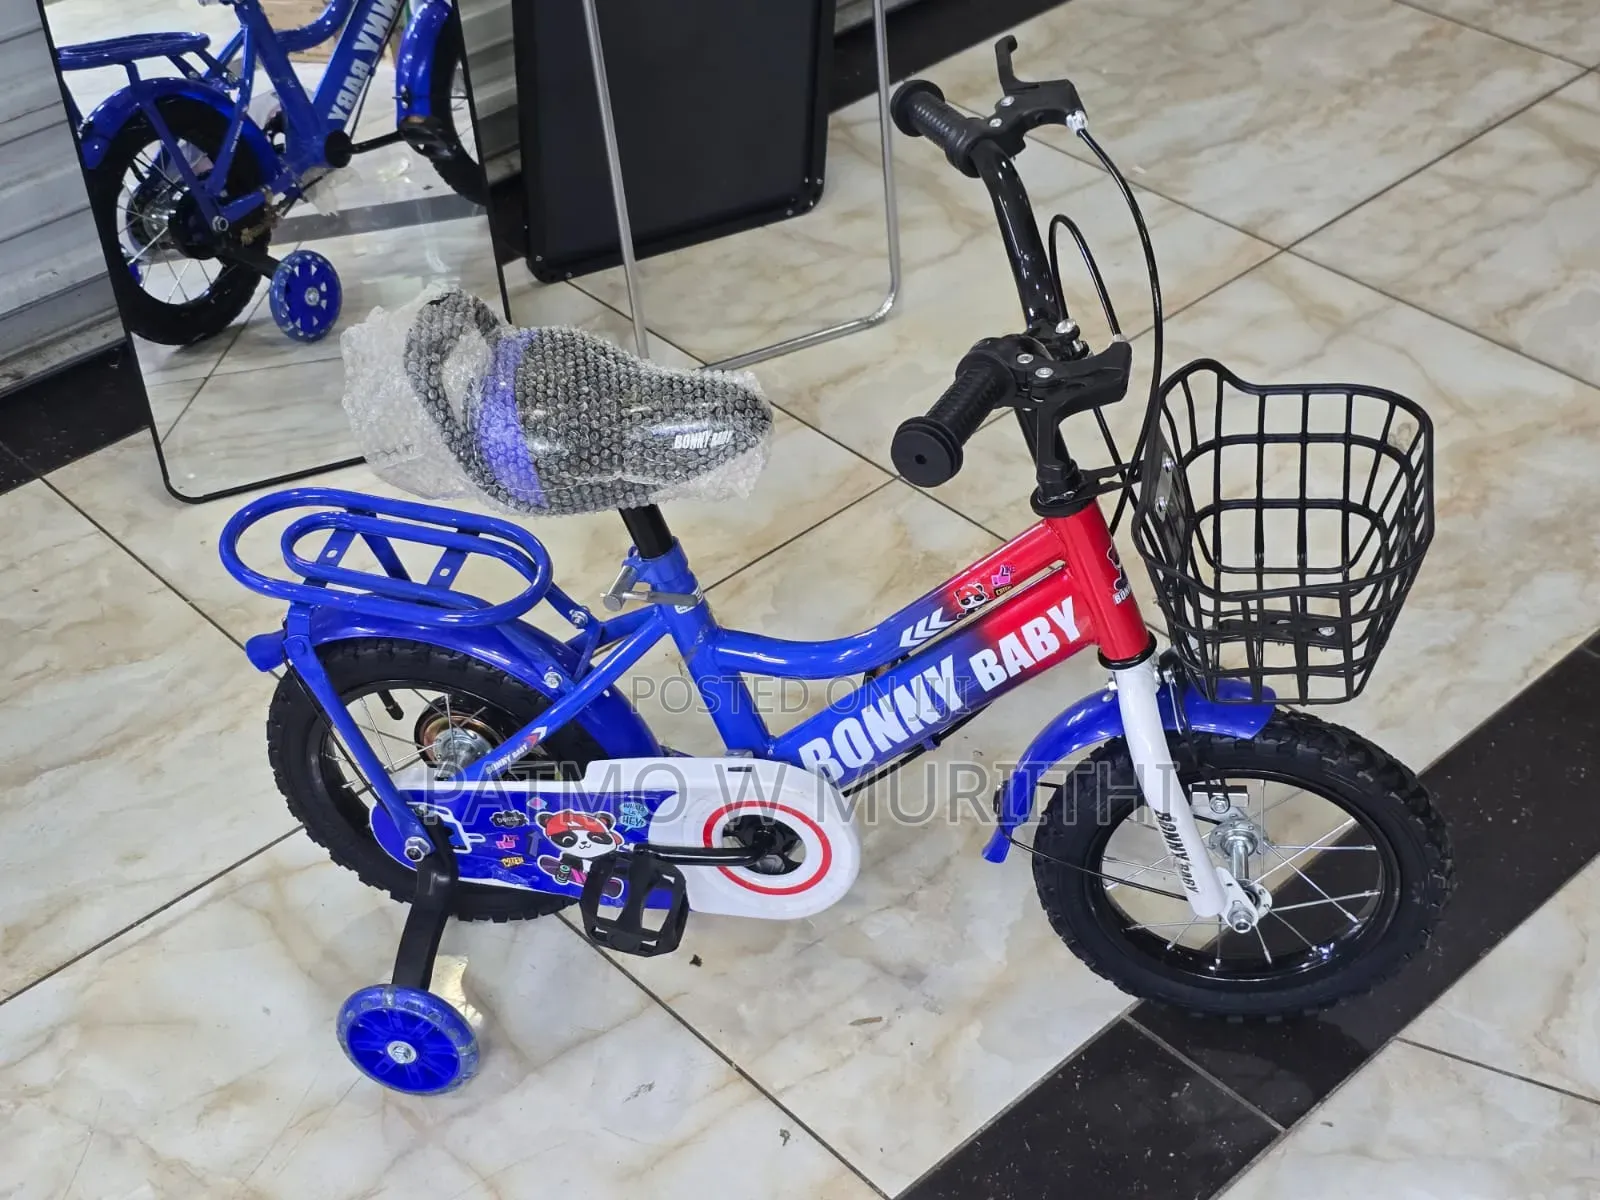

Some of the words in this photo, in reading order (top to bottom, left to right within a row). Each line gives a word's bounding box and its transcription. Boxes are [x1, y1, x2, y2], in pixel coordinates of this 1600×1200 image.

[674, 430, 712, 449] BONNY
[799, 655, 964, 781] BONNY
[969, 596, 1081, 692] BABY
[1154, 809, 1191, 861] BONNY
